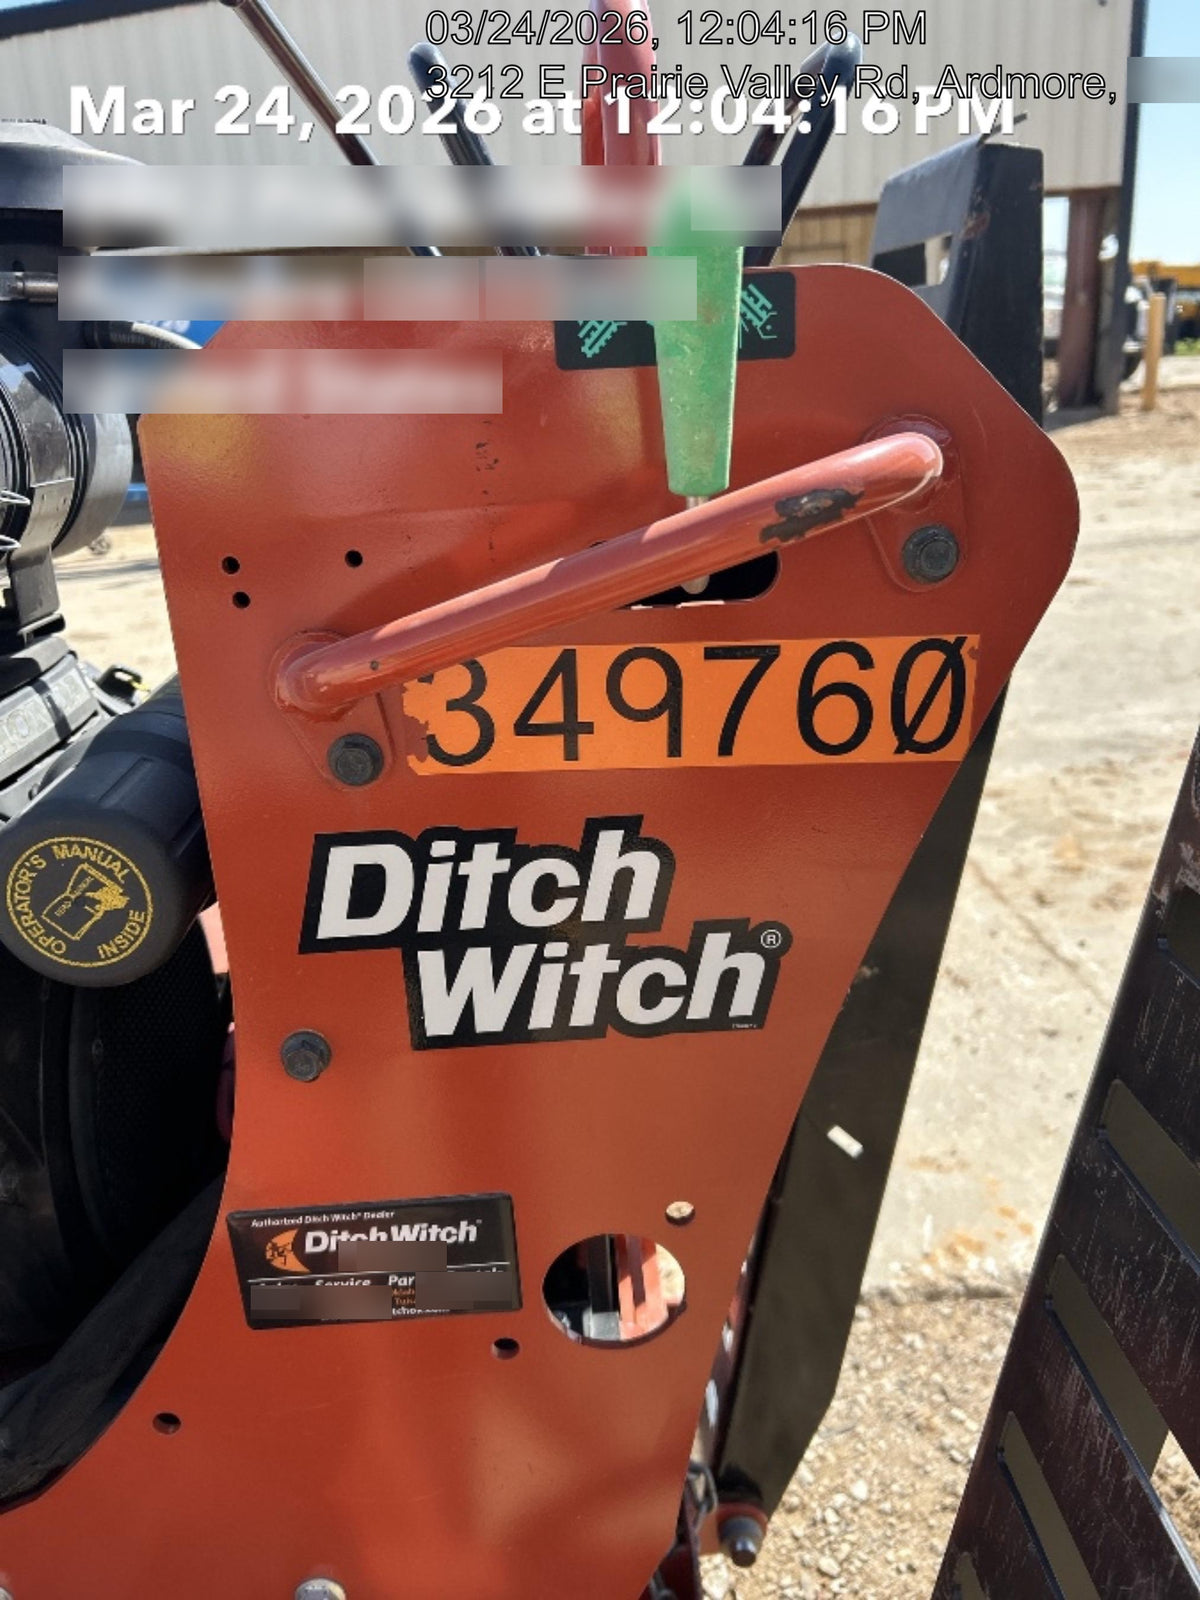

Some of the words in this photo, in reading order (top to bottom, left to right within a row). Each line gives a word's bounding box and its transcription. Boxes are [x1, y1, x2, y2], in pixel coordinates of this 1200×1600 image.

[14, 854, 67, 954] OPERATOR'S
[51, 843, 130, 884] MANUAL
[96, 909, 146, 959] INSIDE
[316, 829, 661, 940] Ditch
